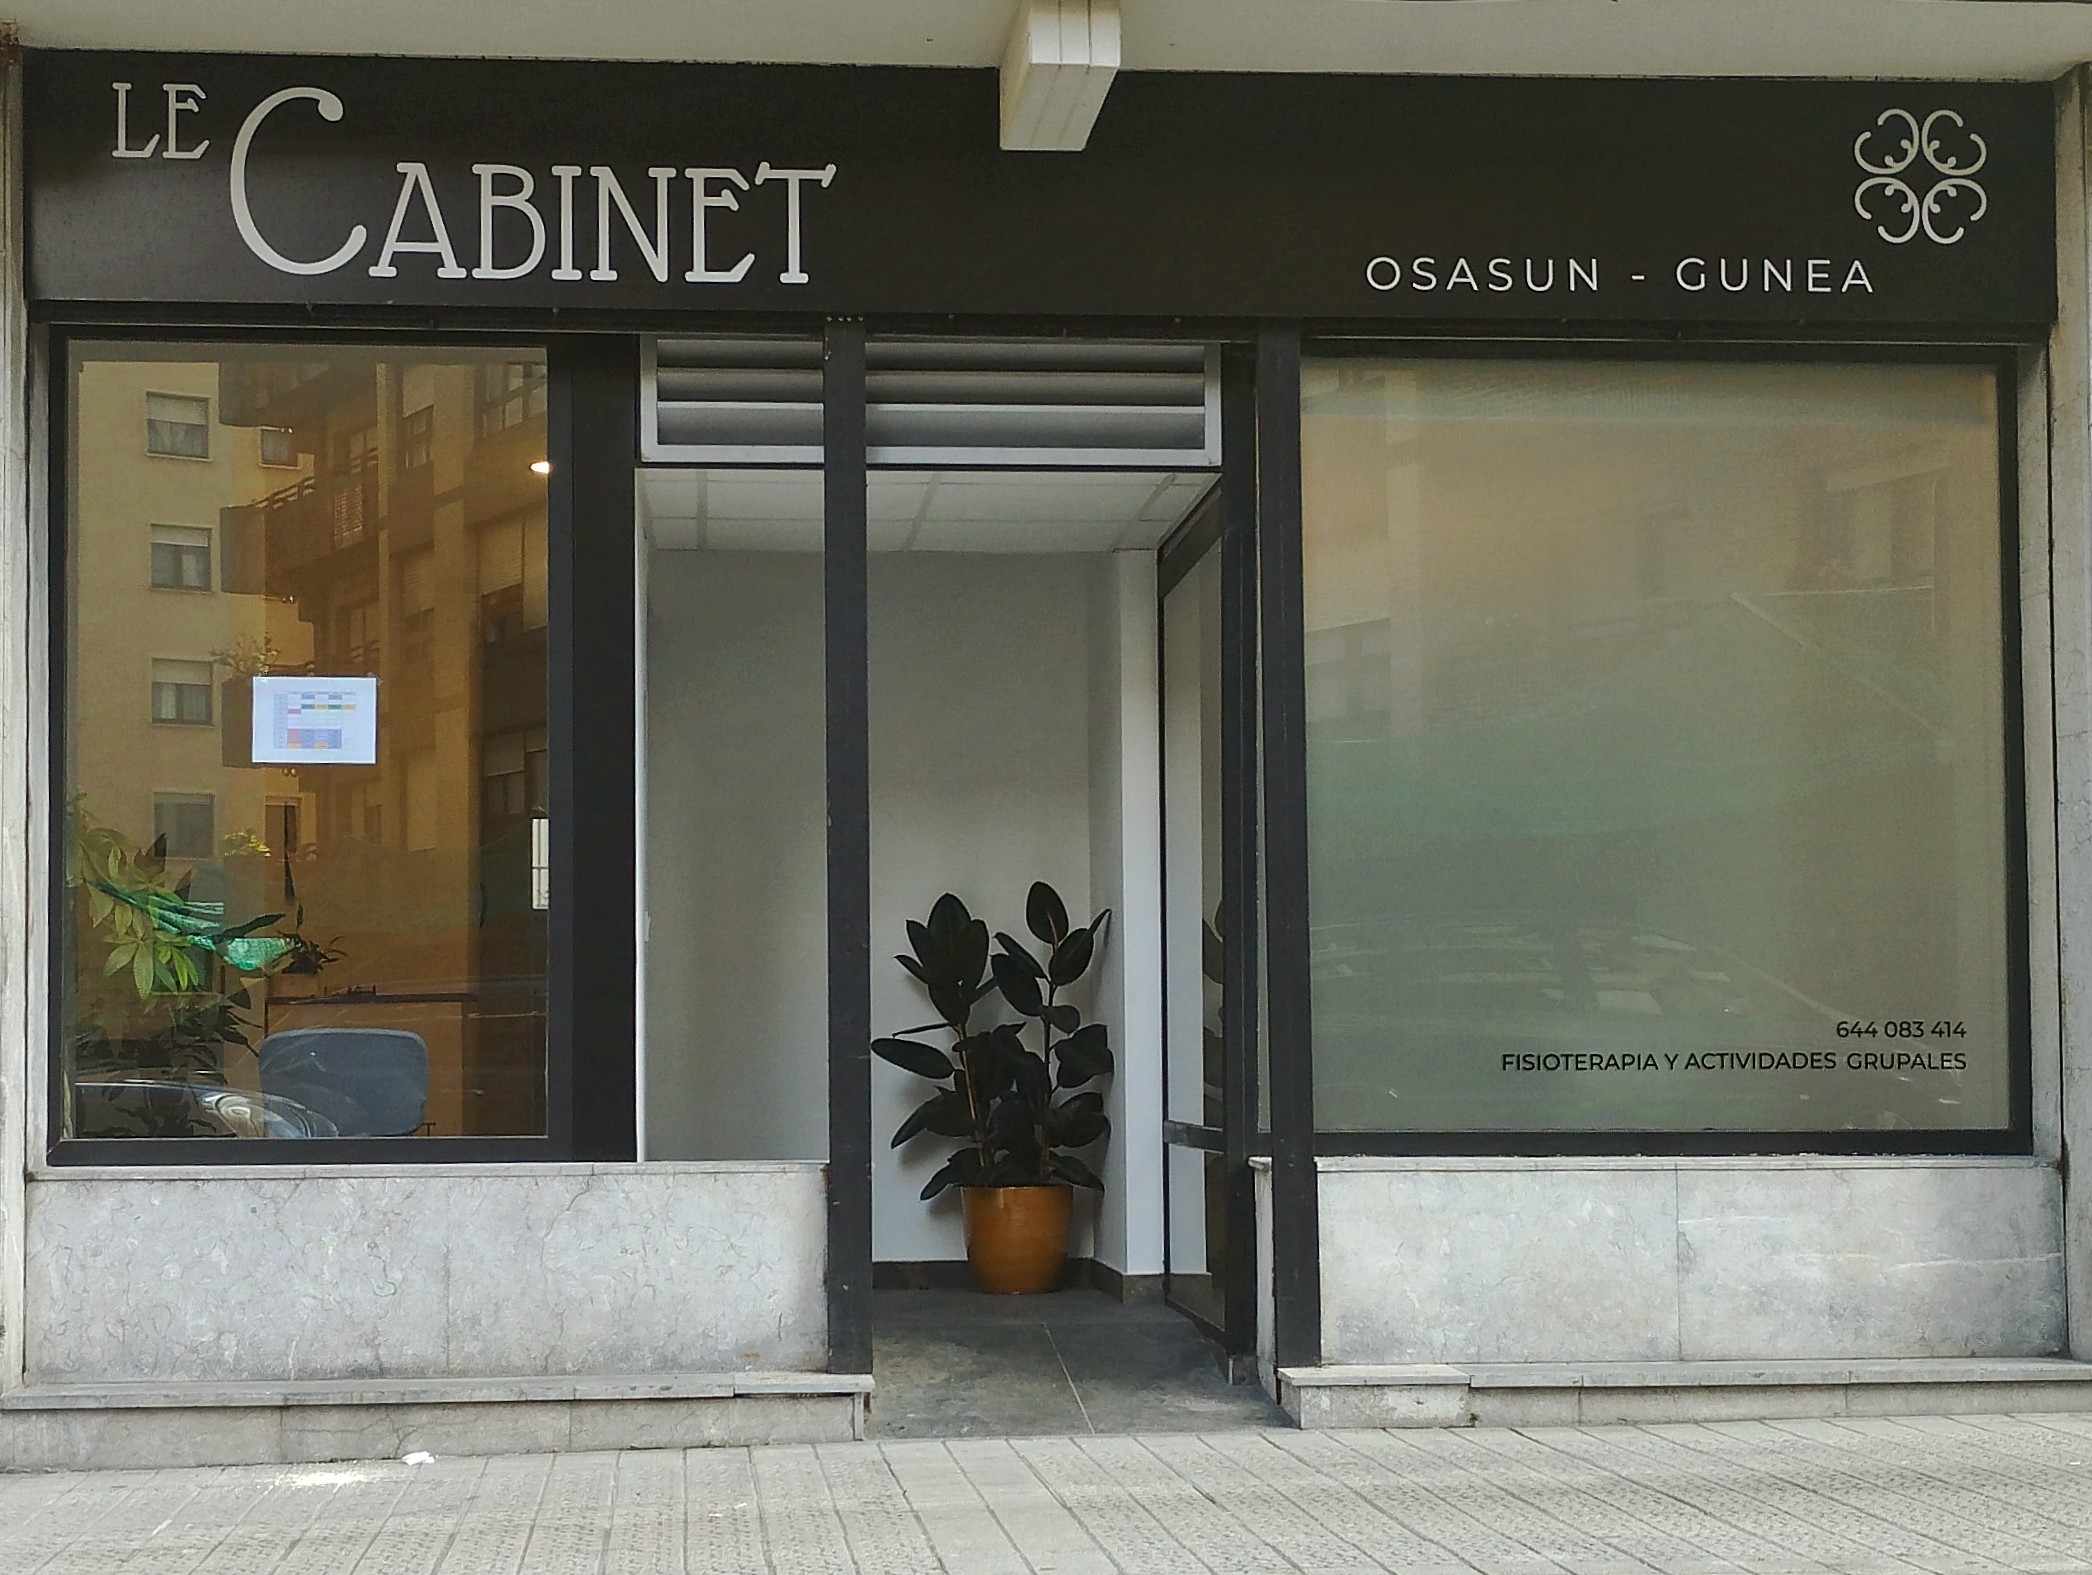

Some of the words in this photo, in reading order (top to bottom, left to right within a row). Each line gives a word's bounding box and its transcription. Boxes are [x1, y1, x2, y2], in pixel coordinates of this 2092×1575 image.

[111, 82, 210, 159] LE
[229, 87, 837, 284] CABINET
[1366, 256, 1599, 293] OSASUN
[1676, 257, 1874, 294] GUNEA
[1835, 1019, 1879, 1040] 644
[1883, 1019, 1926, 1040] 083
[1930, 1019, 1969, 1040] 414
[1501, 1052, 1659, 1072] FISIOTERAPIA
[1663, 1052, 1680, 1072] Y
[1683, 1051, 1837, 1072] ACTIVIDADES
[1846, 1051, 1968, 1072] GRUPALES
